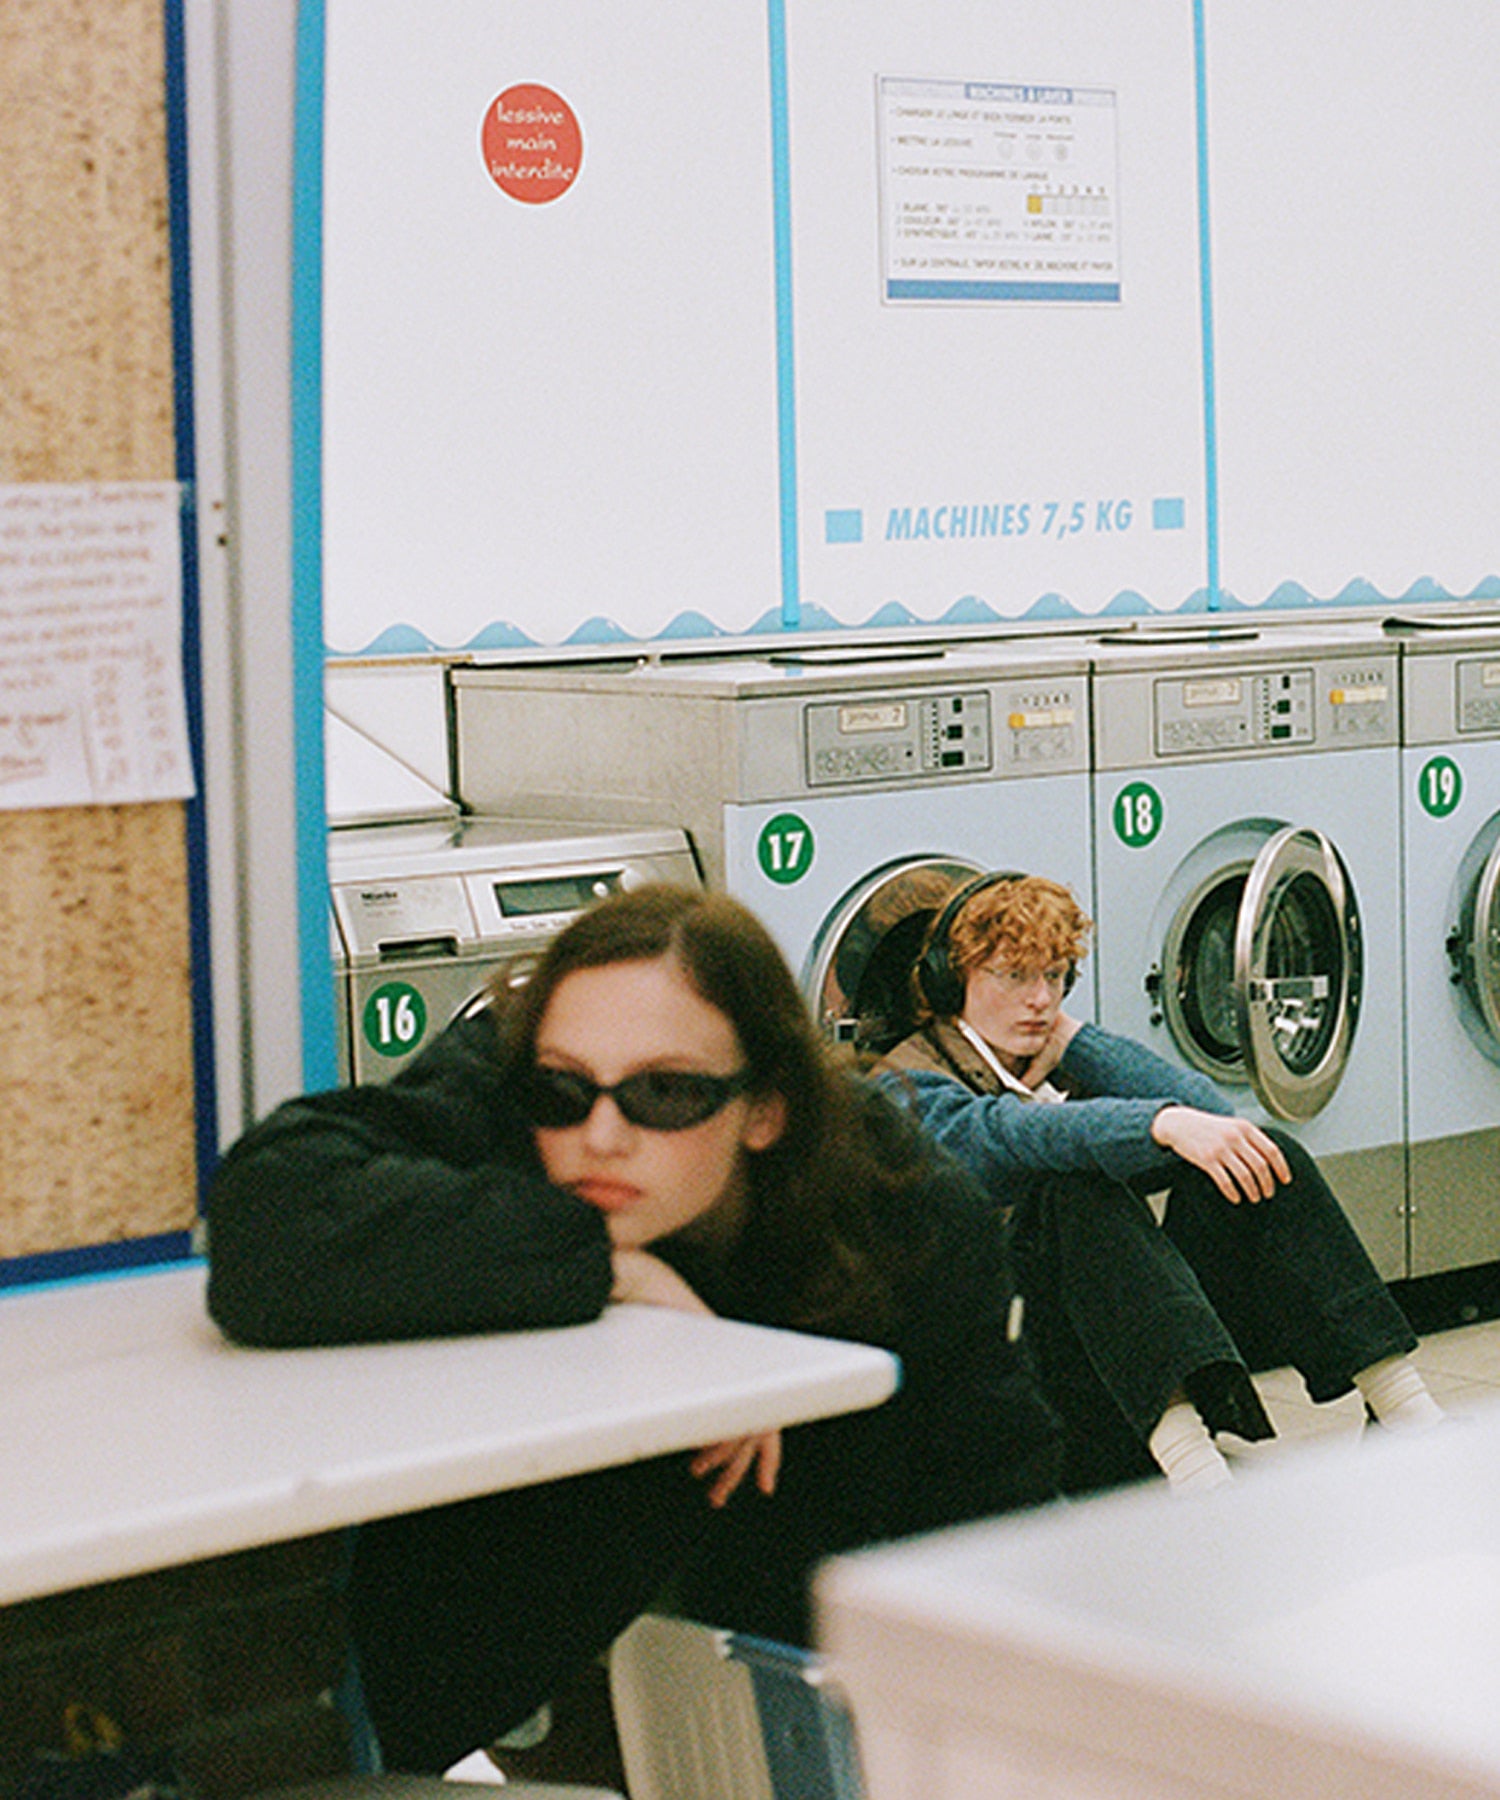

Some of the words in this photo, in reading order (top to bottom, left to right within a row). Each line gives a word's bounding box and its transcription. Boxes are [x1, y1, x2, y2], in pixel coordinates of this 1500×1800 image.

[497, 101, 564, 124] lessive
[507, 133, 557, 150] main
[492, 158, 574, 180] interdite
[884, 503, 1031, 541] MACHINES
[1041, 501, 1086, 540] 7,5
[1096, 499, 1133, 532] KG
[1427, 766, 1454, 805] 19
[1122, 794, 1153, 836] 18
[767, 830, 805, 870] 17
[376, 995, 416, 1044] 16
